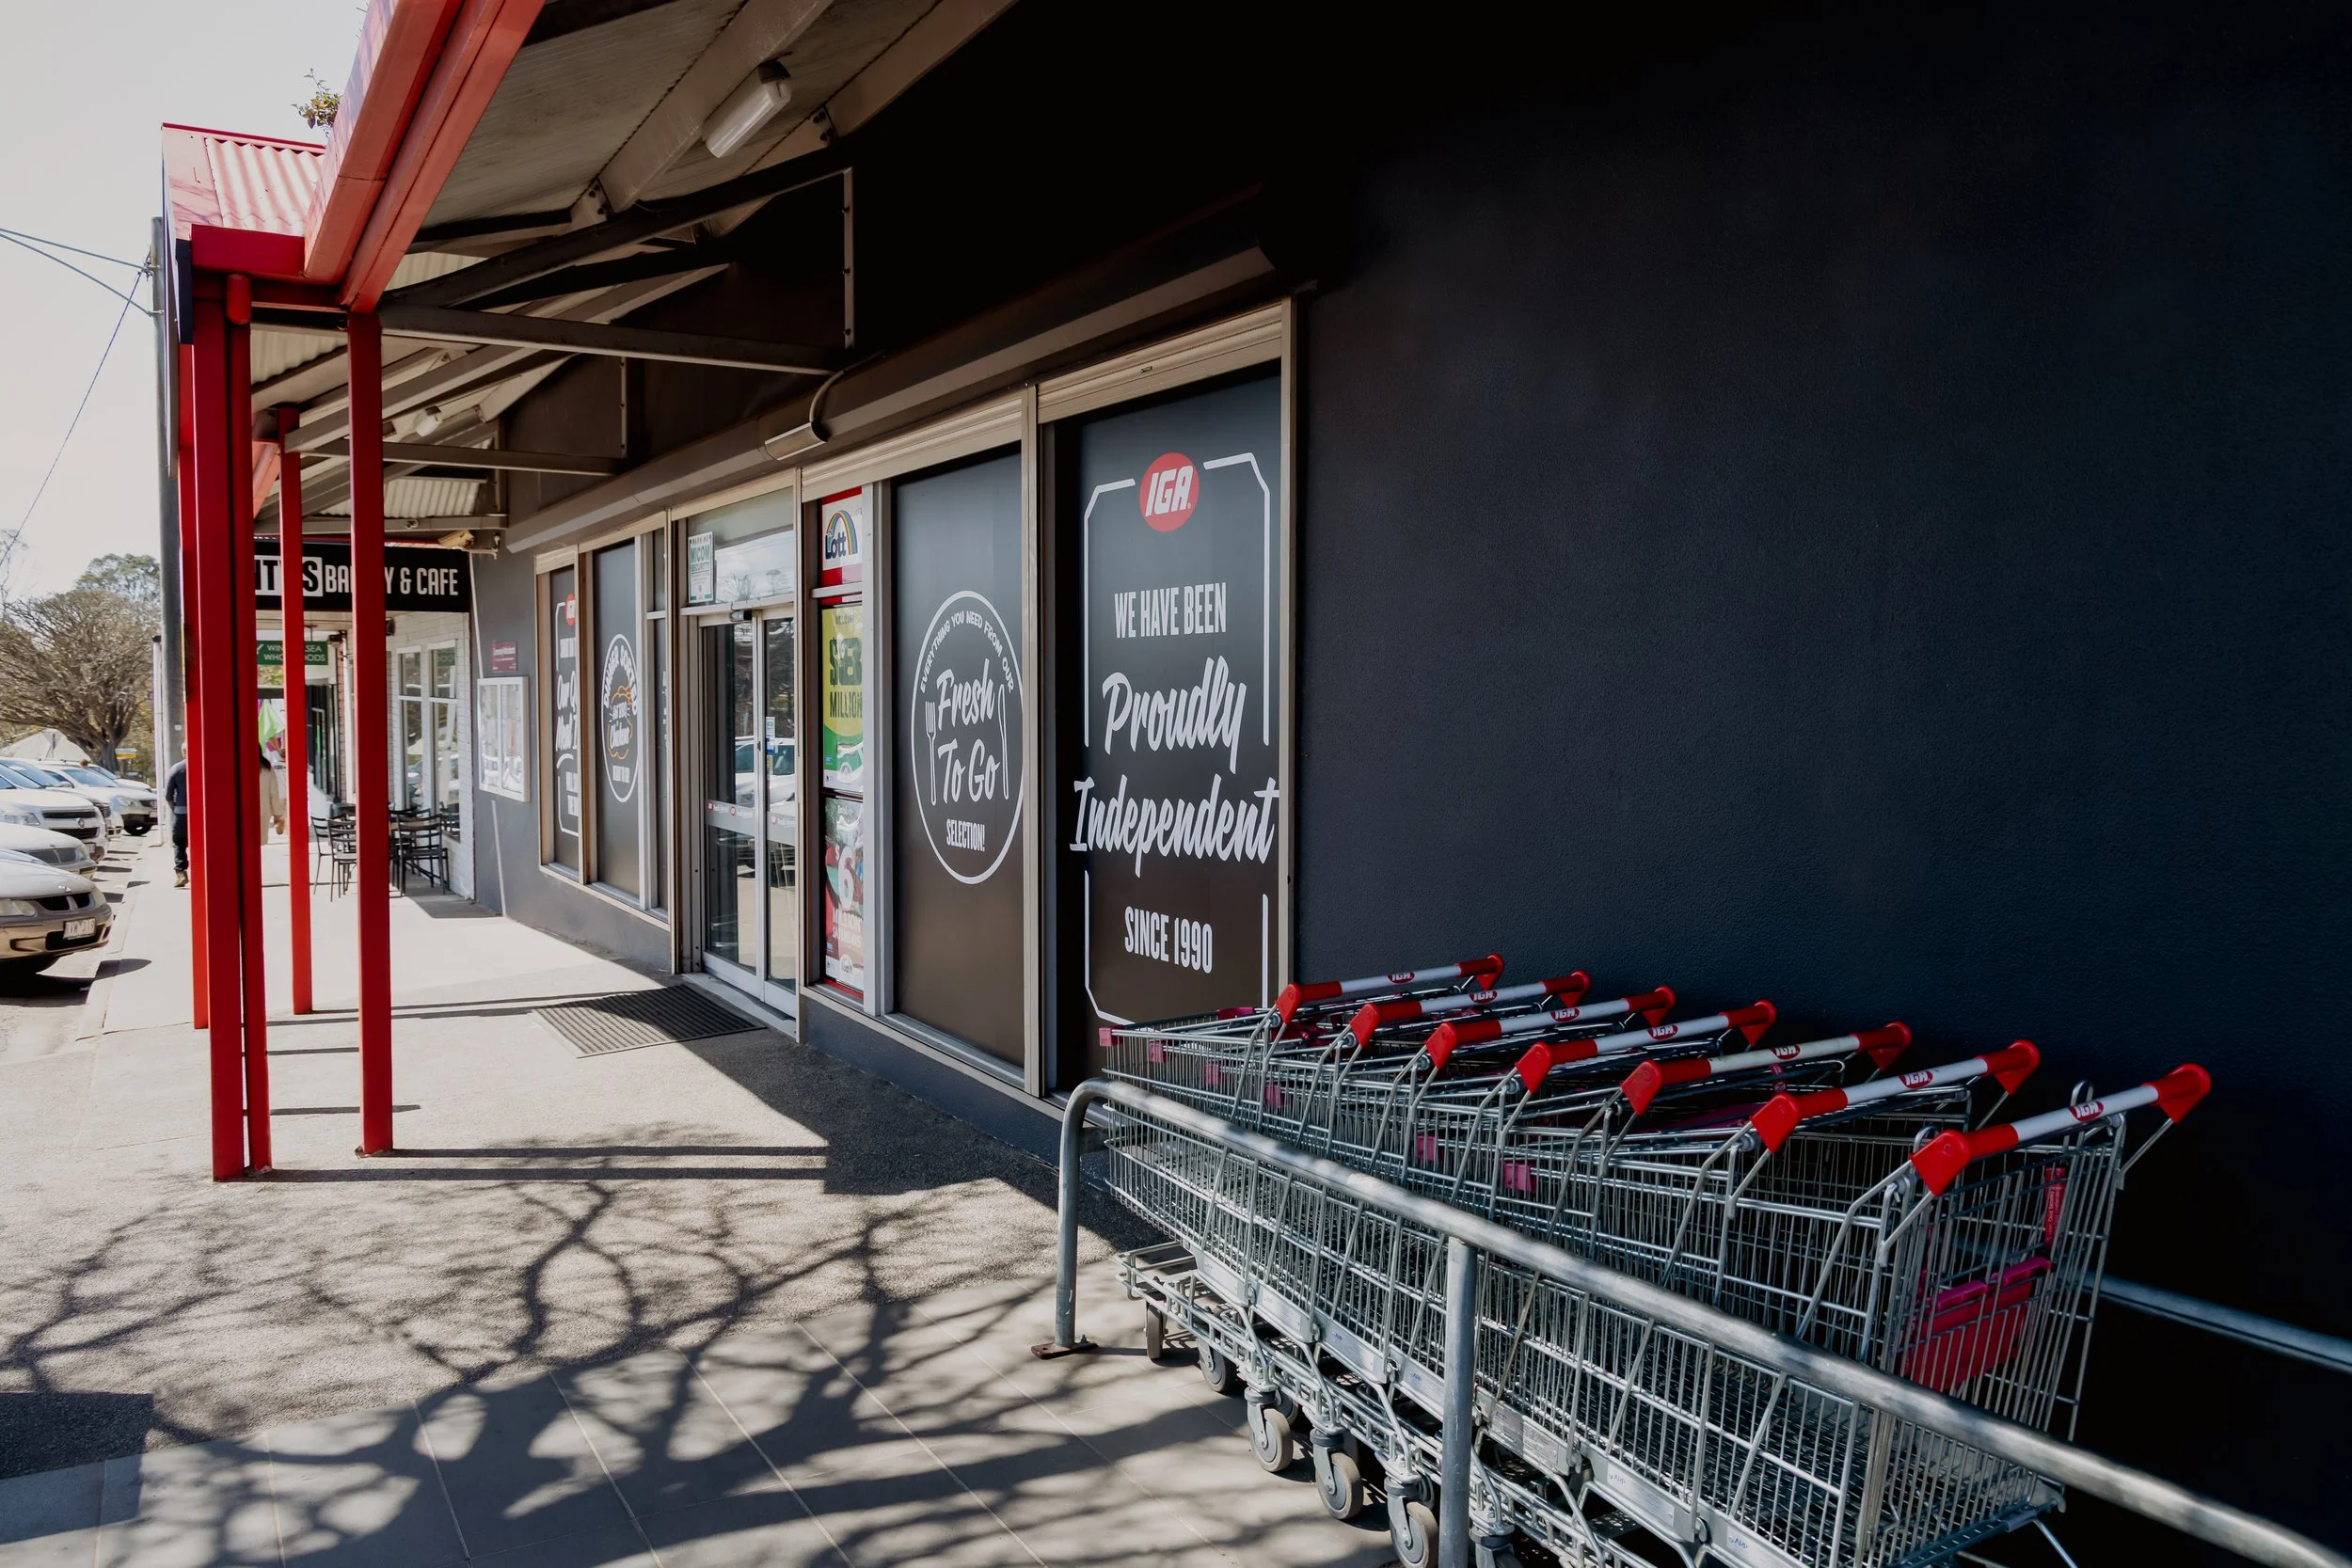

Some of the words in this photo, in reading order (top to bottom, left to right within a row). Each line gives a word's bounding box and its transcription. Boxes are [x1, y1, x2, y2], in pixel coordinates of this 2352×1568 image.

[1145, 466, 1193, 517] IGA
[400, 567, 412, 594] &
[416, 568, 459, 596] CAFE
[1114, 592, 1136, 639] WE
[1140, 586, 1180, 638] HAVE
[1184, 582, 1227, 635] BEEN
[603, 645, 620, 709] DINNER
[920, 620, 950, 694] EVERYTHING
[950, 610, 964, 627] YOU
[965, 610, 983, 629] NEED
[983, 621, 1004, 657] FROM
[1002, 657, 1015, 694] OUR
[829, 691, 863, 718] MILLION
[936, 657, 995, 731] Fresh
[1102, 655, 1248, 775] Proudly
[937, 738, 966, 805] To
[968, 738, 1001, 802] Go
[946, 818, 986, 852] SELECTION!
[1069, 773, 1280, 879] Independent
[1124, 906, 1169, 963] SINCE
[1174, 917, 1213, 974] 1990
[2074, 1101, 2099, 1118] IGA
